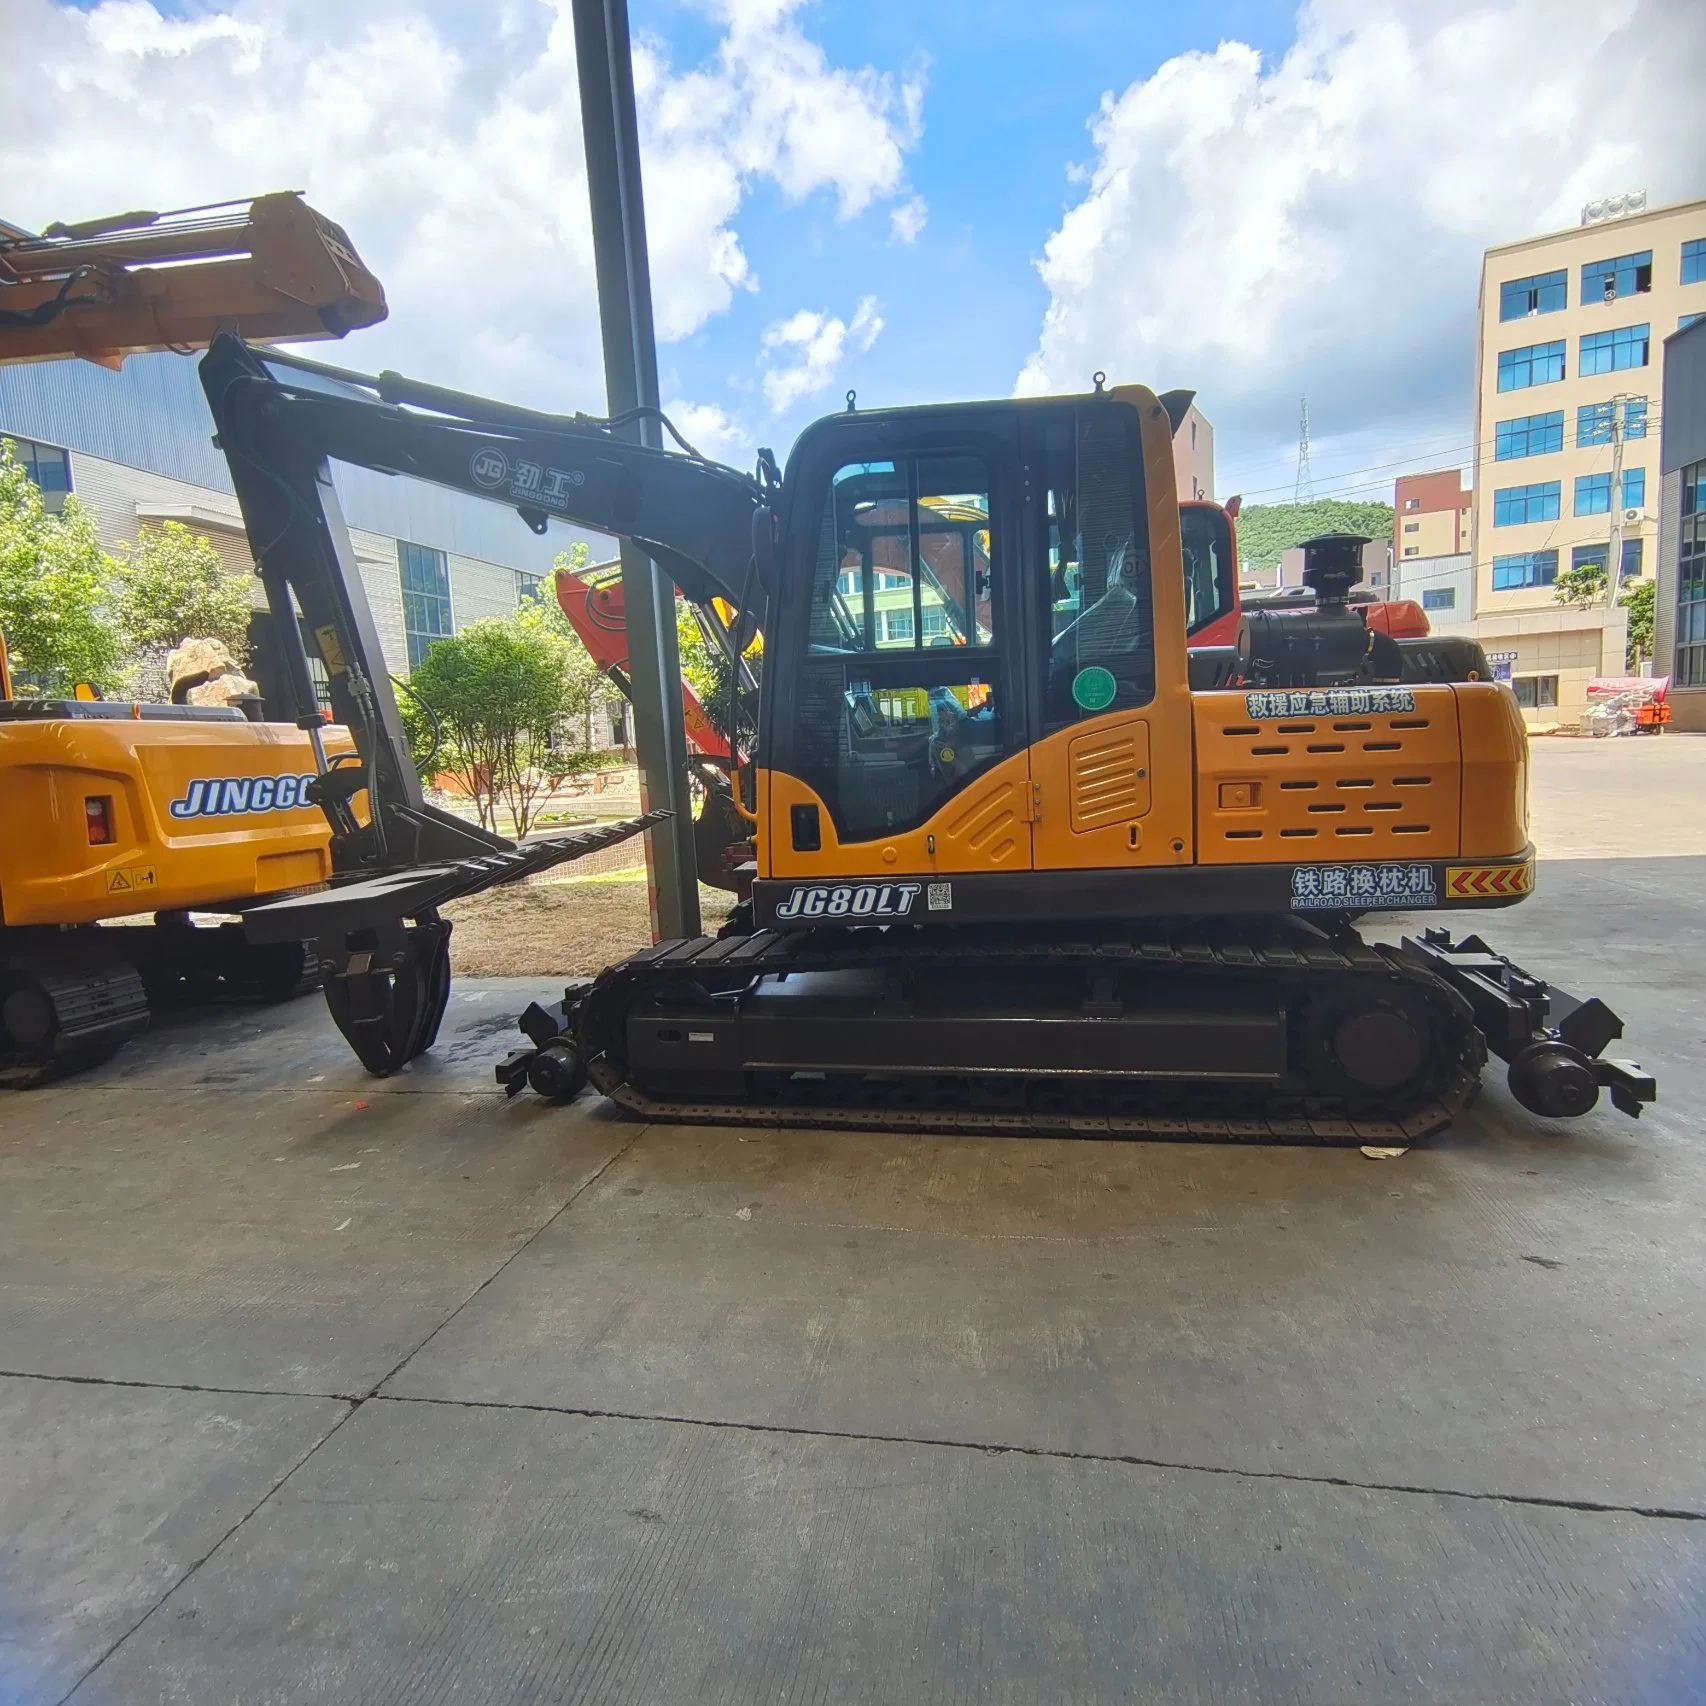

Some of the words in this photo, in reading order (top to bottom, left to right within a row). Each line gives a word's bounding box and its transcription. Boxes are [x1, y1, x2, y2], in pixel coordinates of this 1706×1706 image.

[476, 457, 502, 478] JG
[1247, 689, 1414, 717] 救援应急辅助系统
[1294, 867, 1433, 896] 铁路换枕机
[778, 886, 919, 916] JG80LT
[1292, 897, 1341, 908] RAILROAD
[1342, 896, 1385, 906] SLEEPER
[1386, 895, 1435, 905] CHANGER
